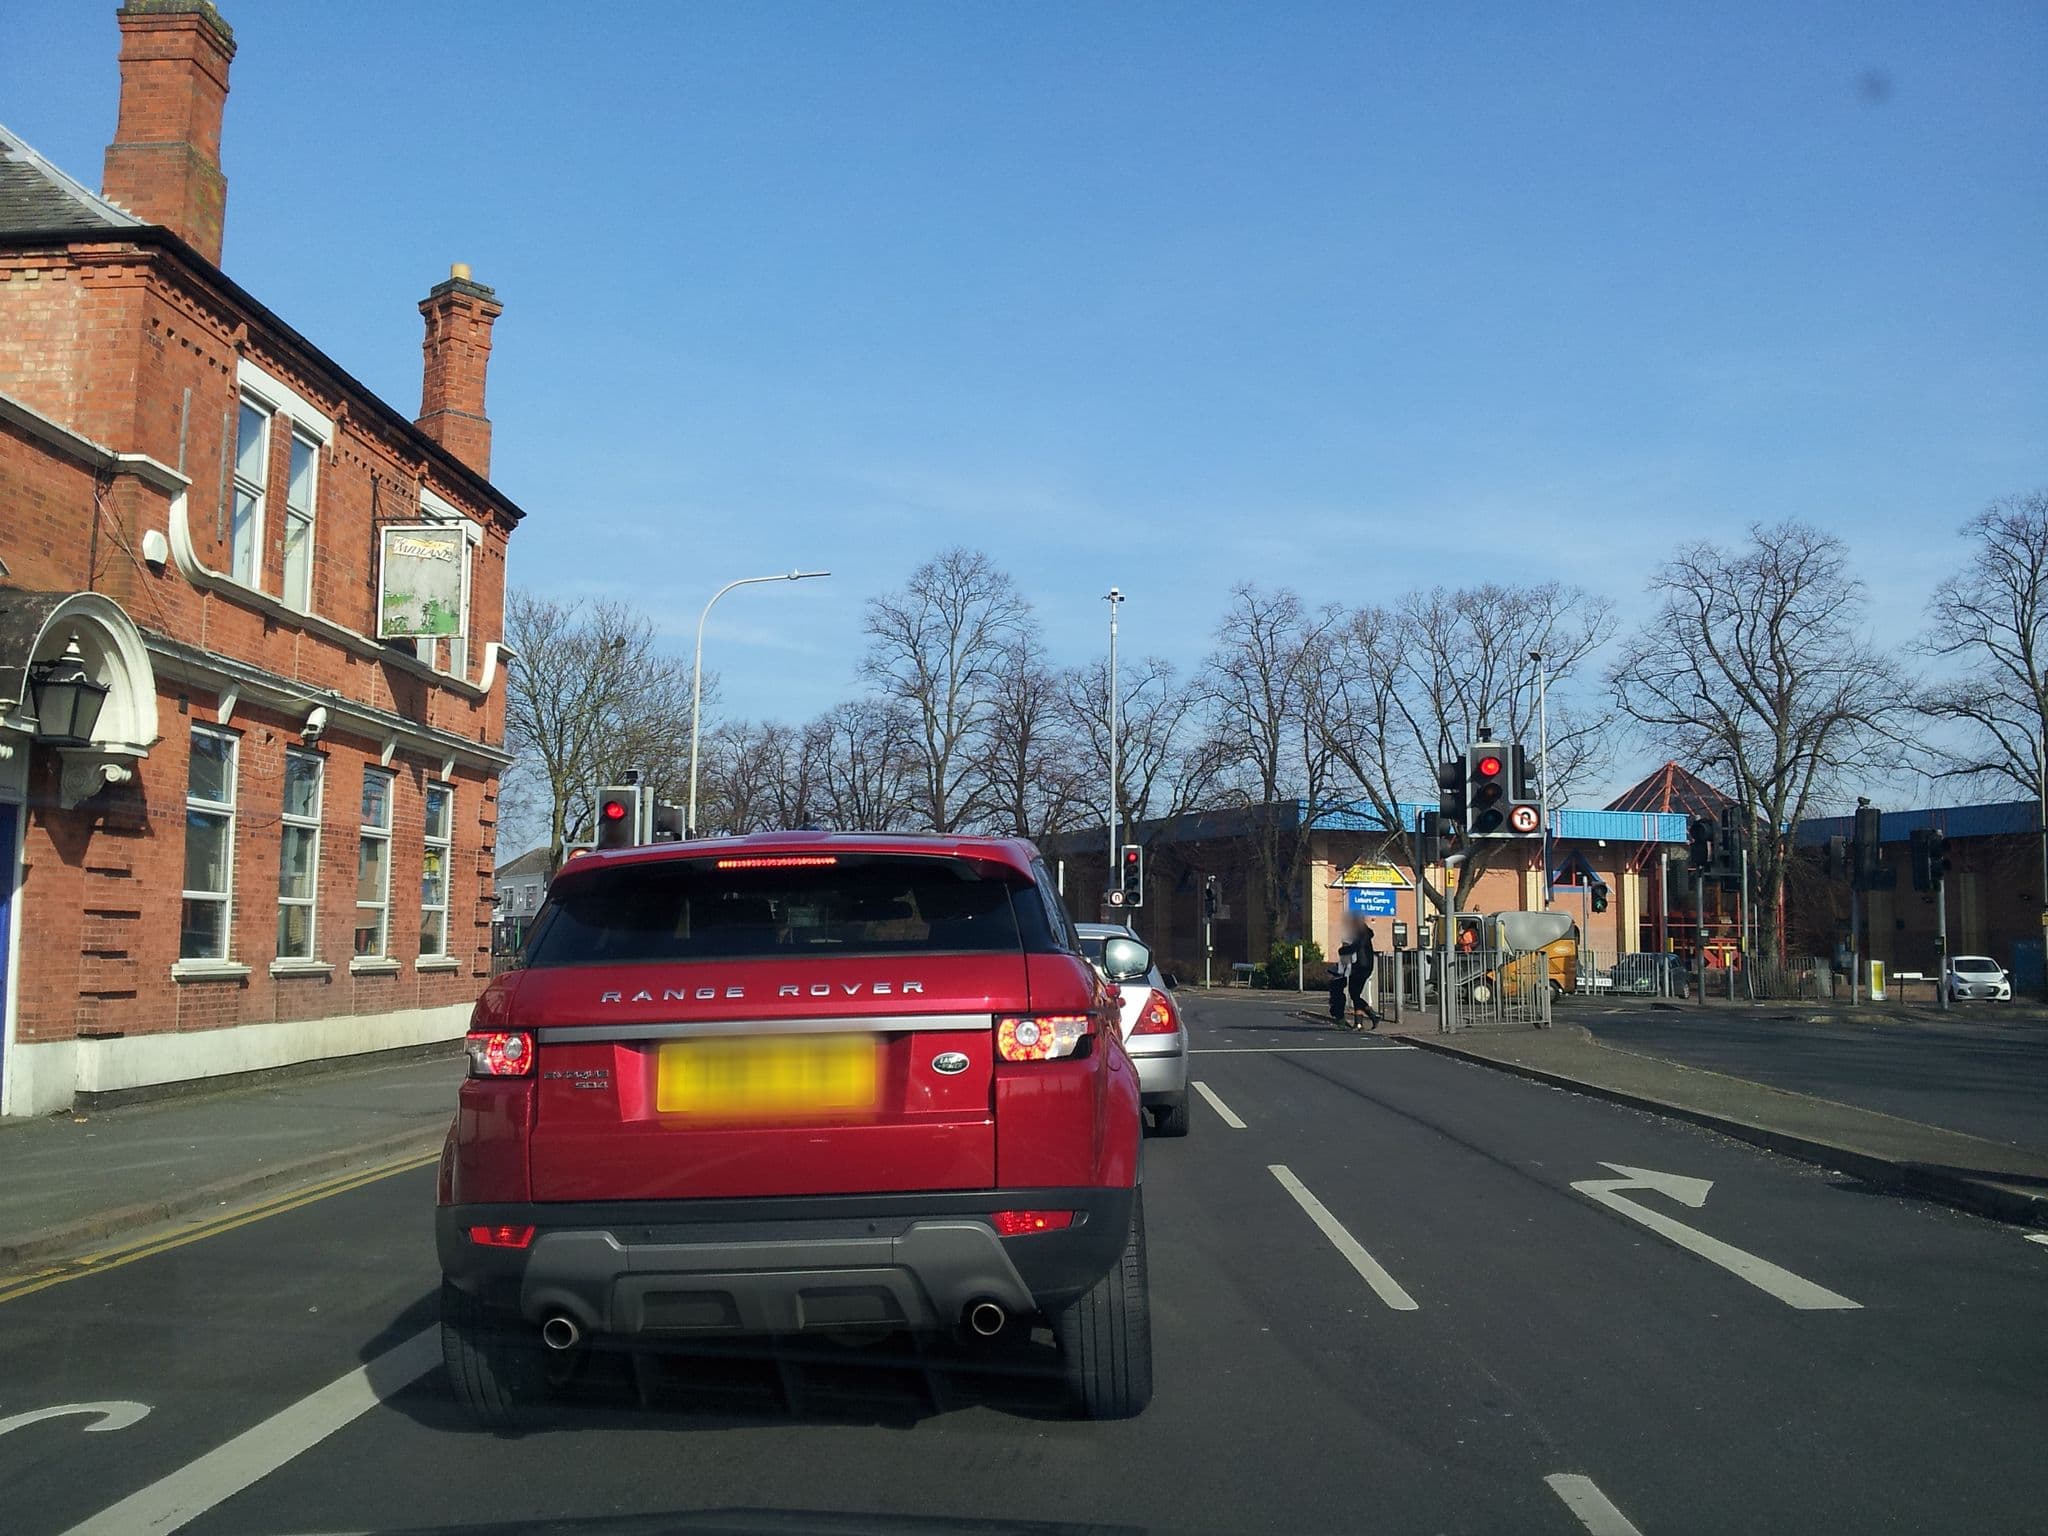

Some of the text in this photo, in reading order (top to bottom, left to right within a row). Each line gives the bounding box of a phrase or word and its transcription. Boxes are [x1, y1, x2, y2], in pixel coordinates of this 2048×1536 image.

[1366, 904, 1385, 913] Library
[600, 981, 924, 1003] RANGE ROVER
